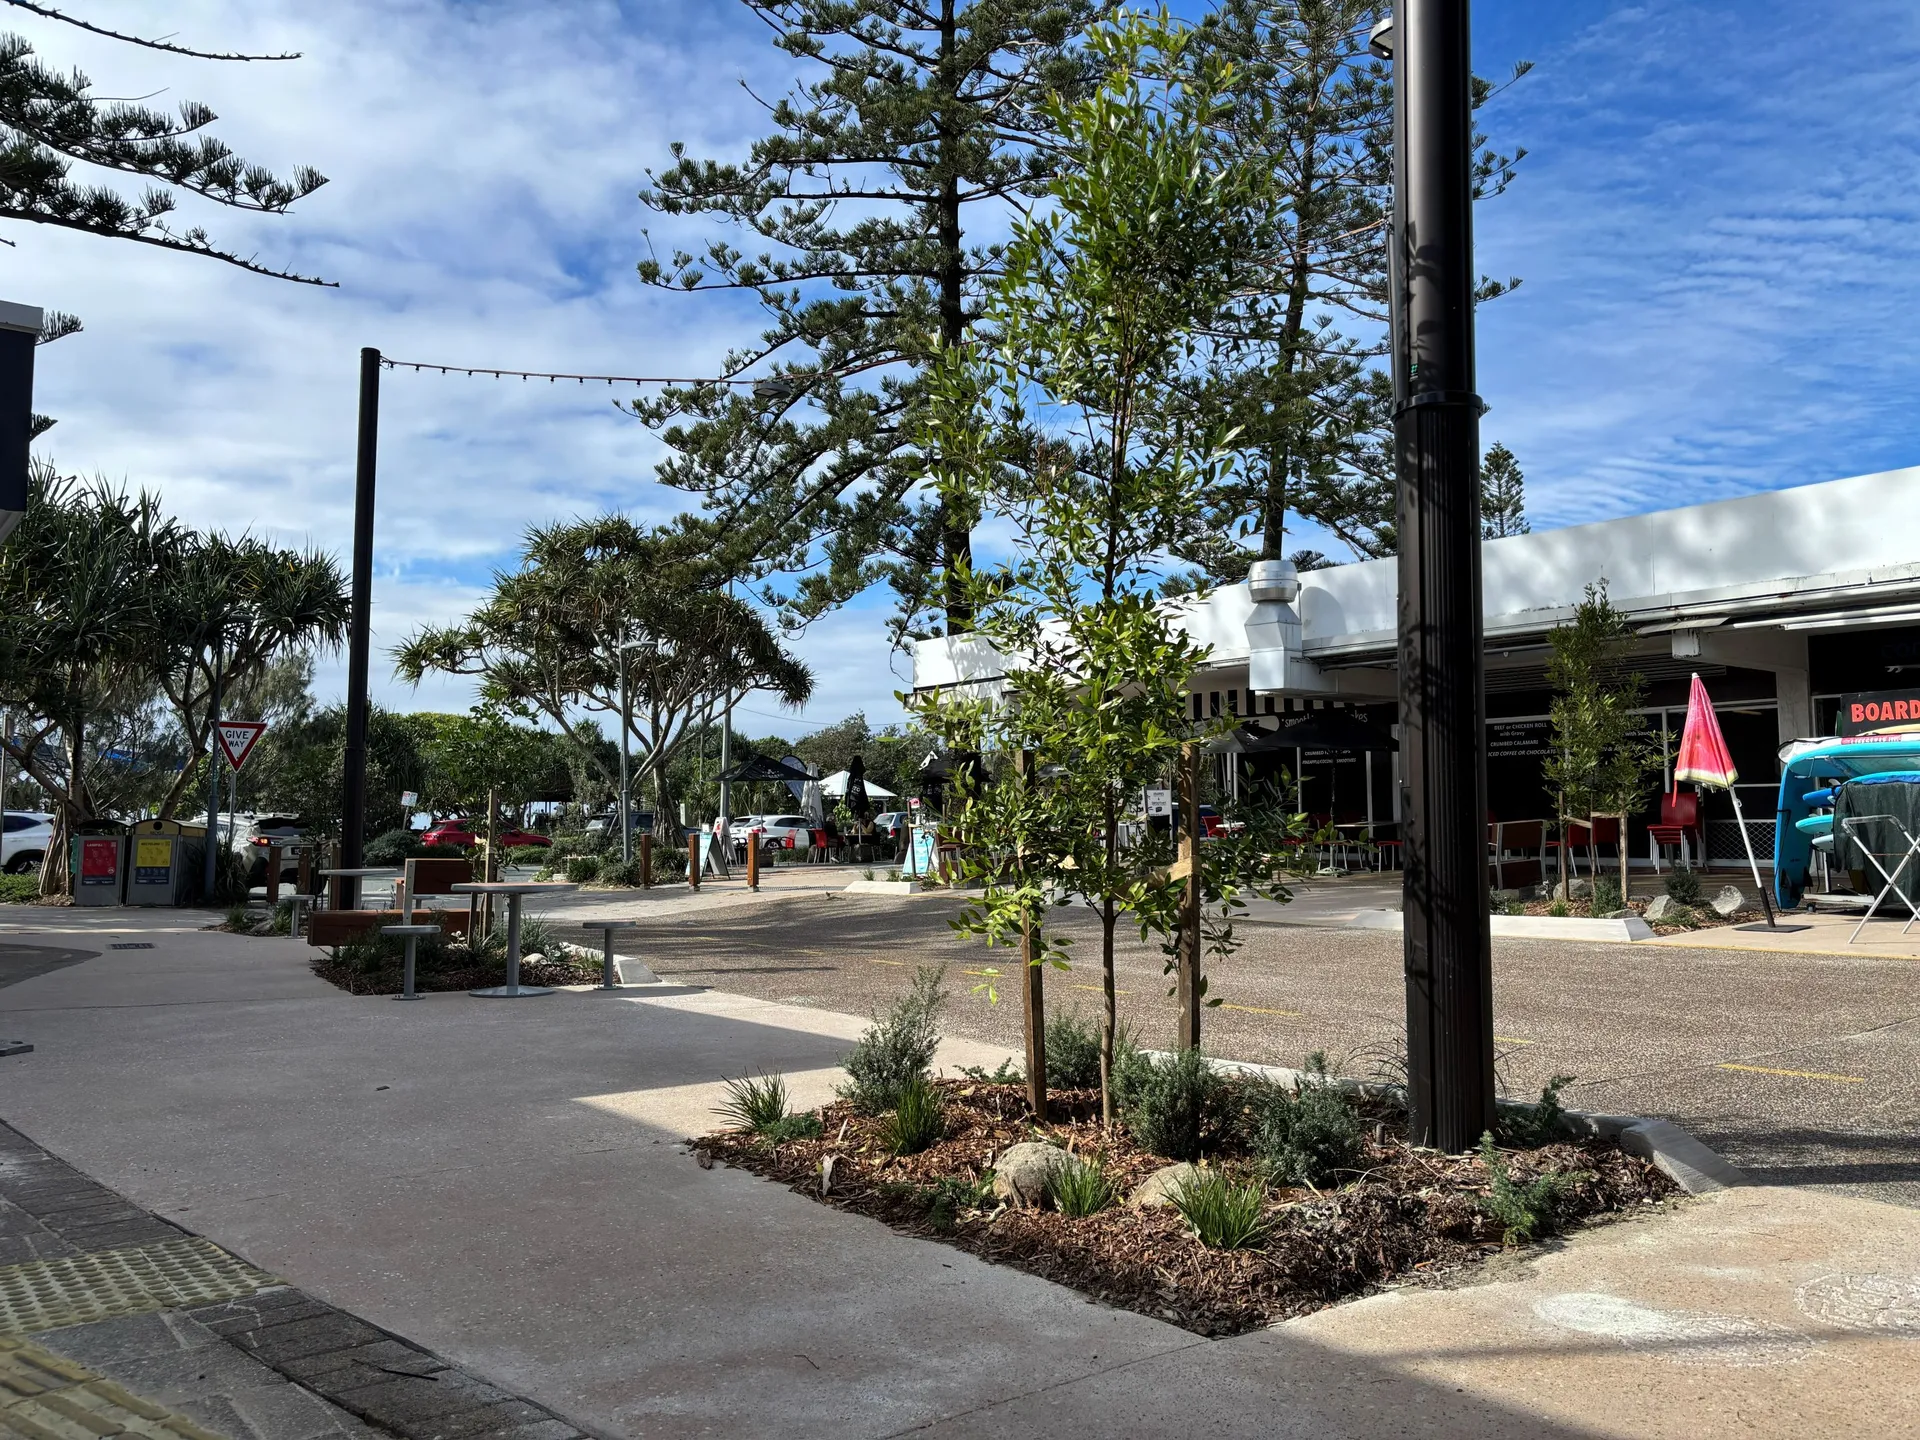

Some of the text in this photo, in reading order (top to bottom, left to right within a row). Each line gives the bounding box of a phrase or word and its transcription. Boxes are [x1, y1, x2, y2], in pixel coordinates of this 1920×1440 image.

[1851, 700, 1920, 722] BOARD
[225, 730, 249, 740] GIVE
[228, 740, 245, 748] WAY
